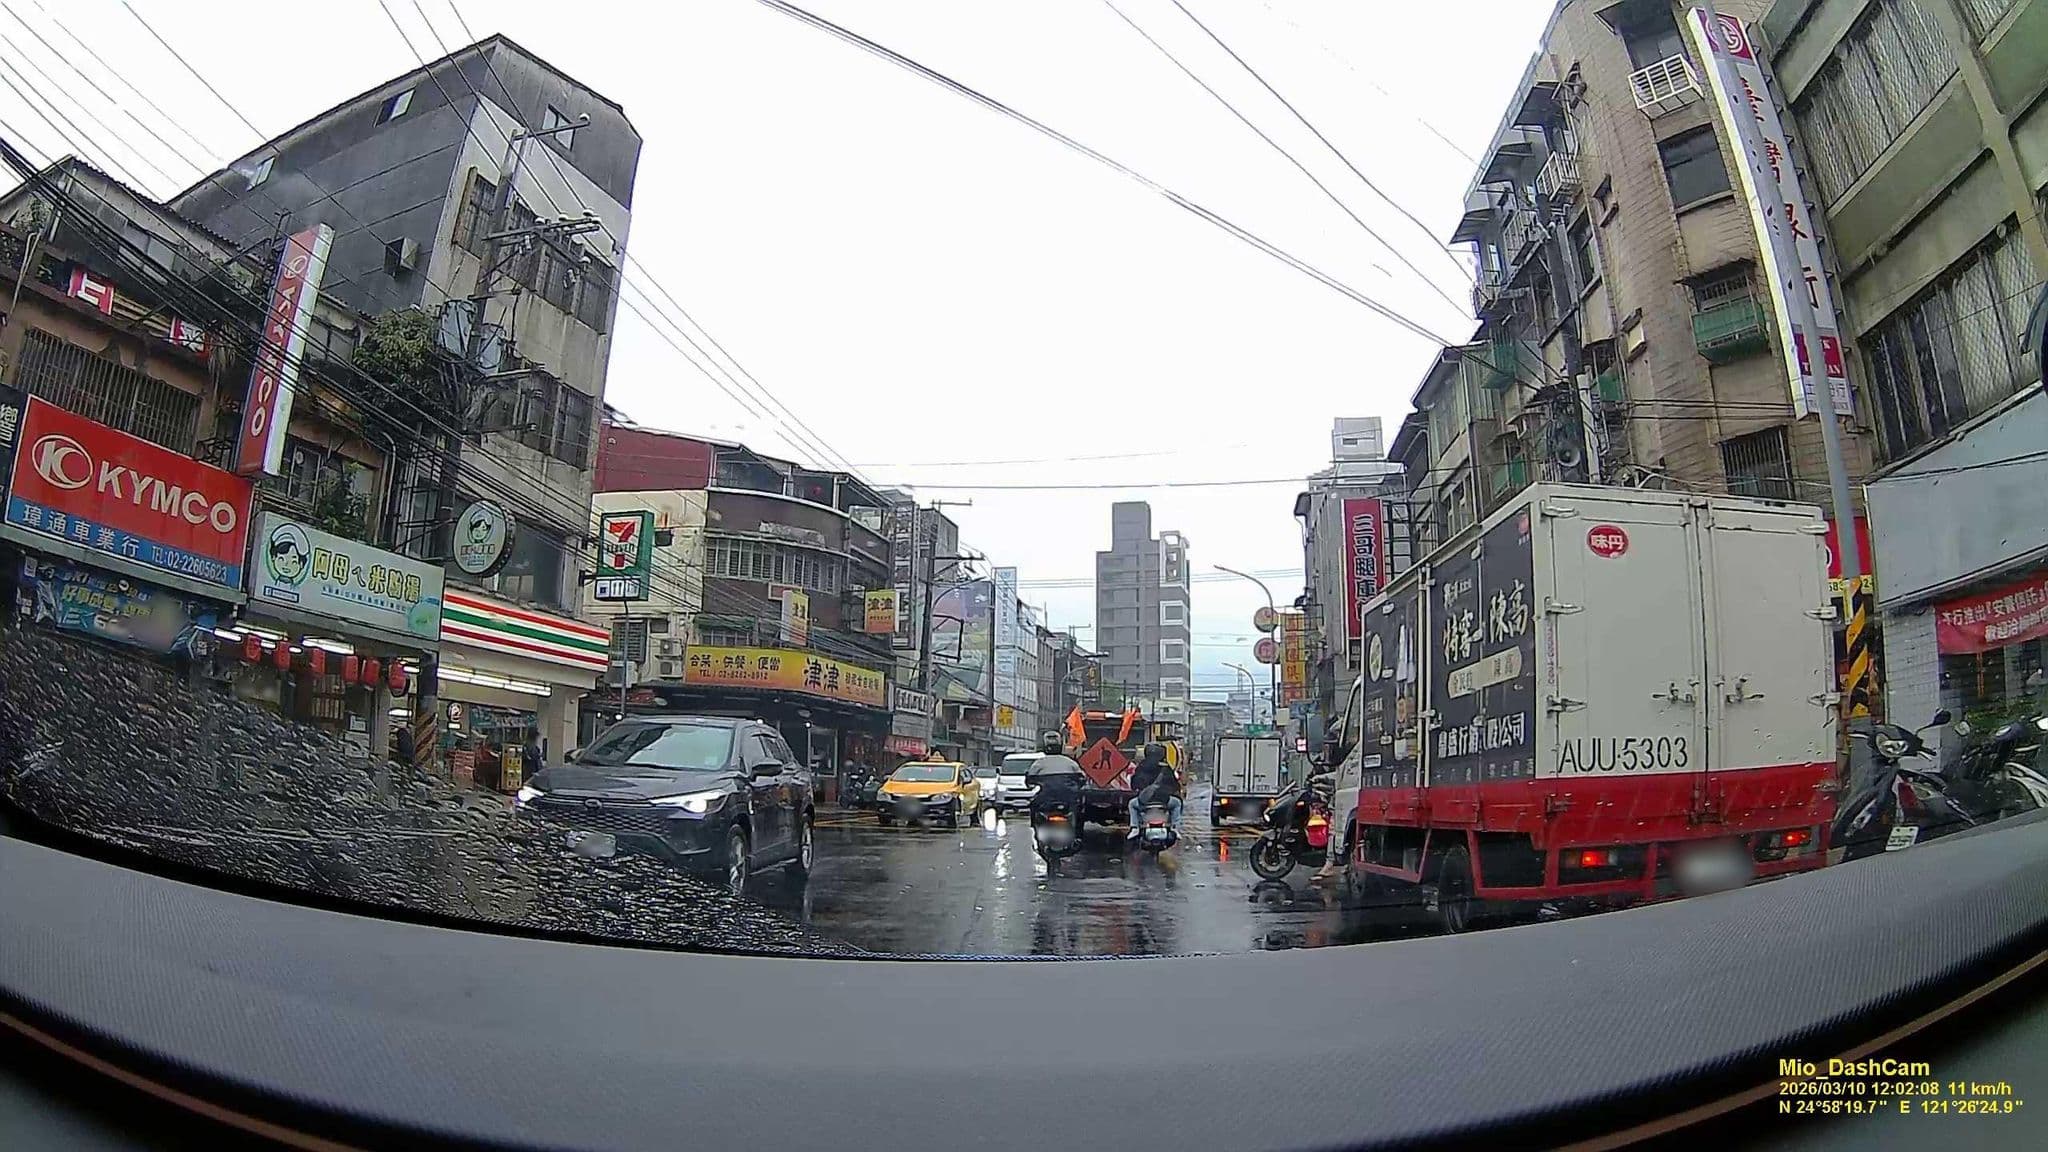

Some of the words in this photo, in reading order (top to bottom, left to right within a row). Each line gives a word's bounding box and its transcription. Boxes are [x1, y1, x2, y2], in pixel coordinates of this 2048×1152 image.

[97, 460, 237, 533] KYMCO
[1591, 534, 1625, 550] 味丹
[151, 545, 227, 582] TEL:02-22605623
[1351, 513, 1377, 621] 三哥腿庫
[803, 657, 841, 692] 津津
[1559, 736, 1689, 774] AUU-5303
